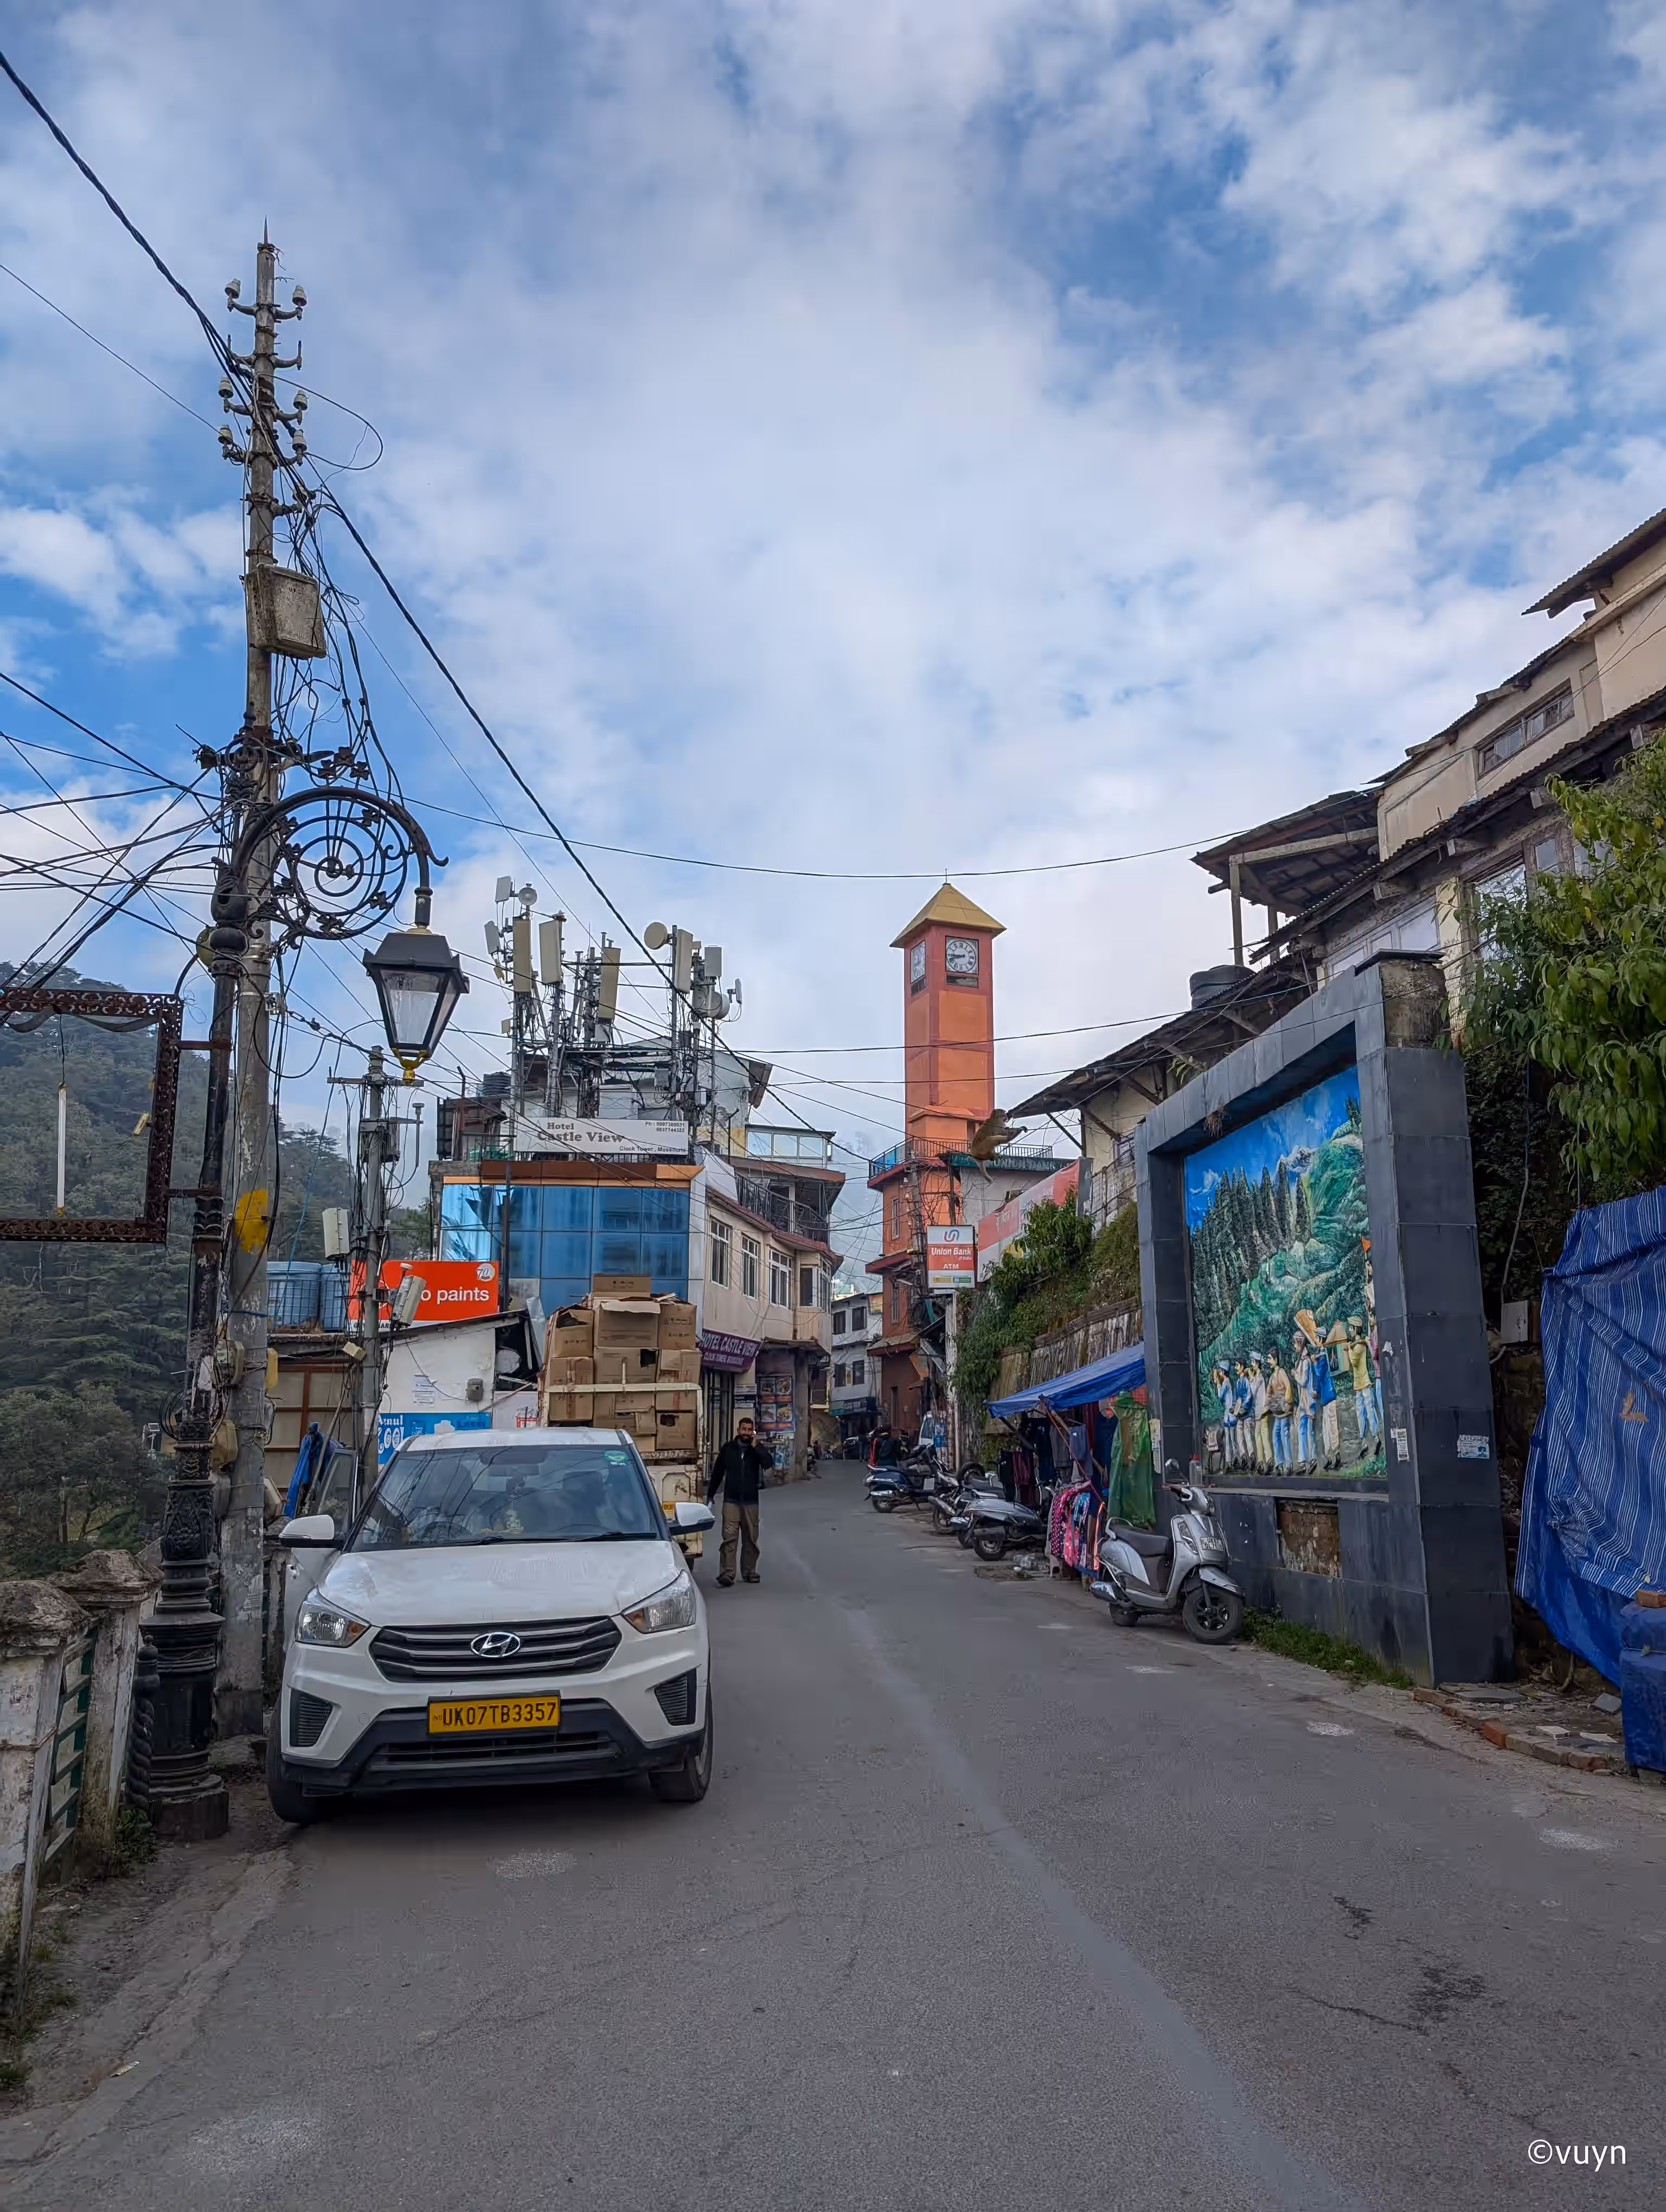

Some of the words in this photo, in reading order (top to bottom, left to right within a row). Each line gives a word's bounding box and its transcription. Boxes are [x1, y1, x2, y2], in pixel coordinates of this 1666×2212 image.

[537, 1131, 582, 1142] Castle
[586, 1132, 624, 1142] View
[931, 1247, 952, 1255] Union
[953, 1247, 972, 1255] Bank
[477, 1268, 489, 1279] 70
[437, 1287, 490, 1305] paints
[700, 1332, 721, 1349] HOTEL
[720, 1336, 744, 1354] CASTLE
[443, 1701, 556, 1727] UK07TB3357
